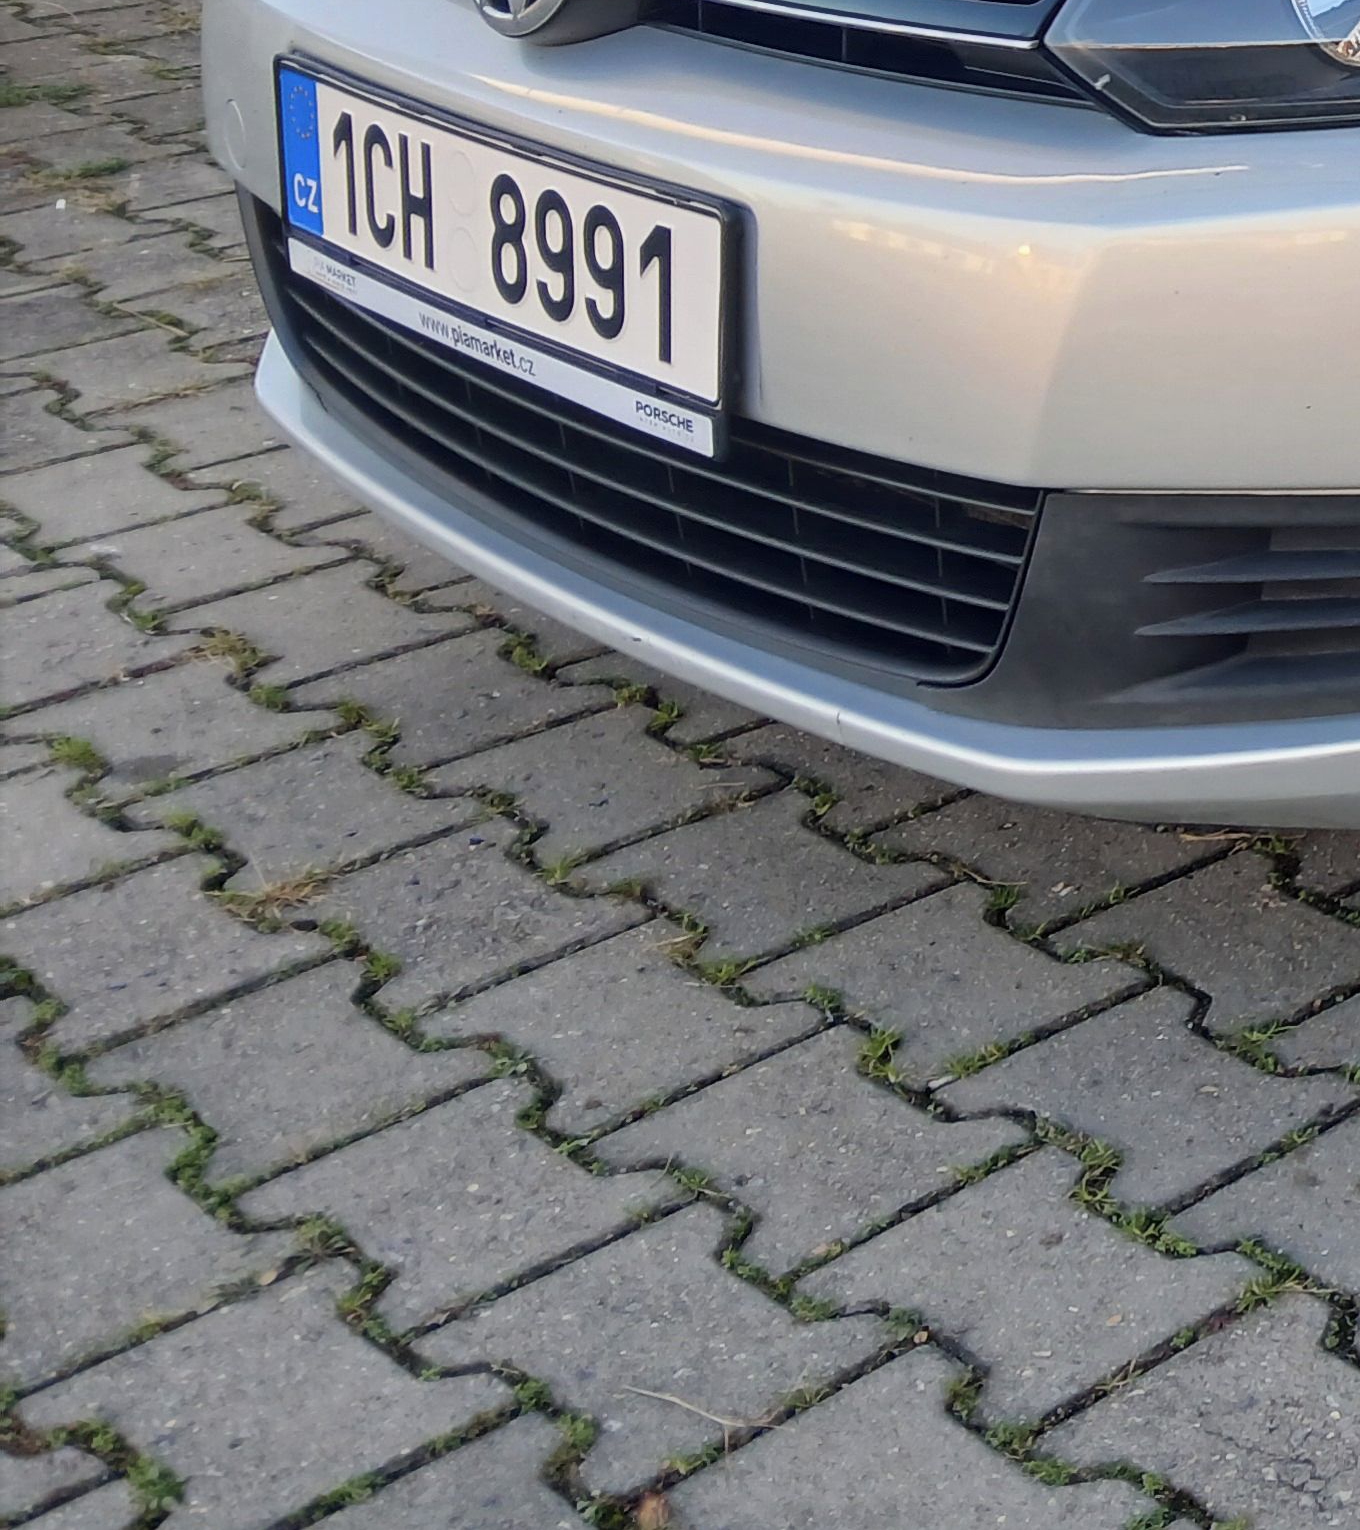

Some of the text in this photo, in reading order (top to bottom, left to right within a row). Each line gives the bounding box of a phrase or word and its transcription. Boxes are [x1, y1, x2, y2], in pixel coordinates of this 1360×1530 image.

[293, 171, 319, 214] CZ
[331, 110, 674, 366] 1CH 8991
[418, 311, 537, 377] www.piamarket.cz
[635, 399, 695, 434] PORSCHE
